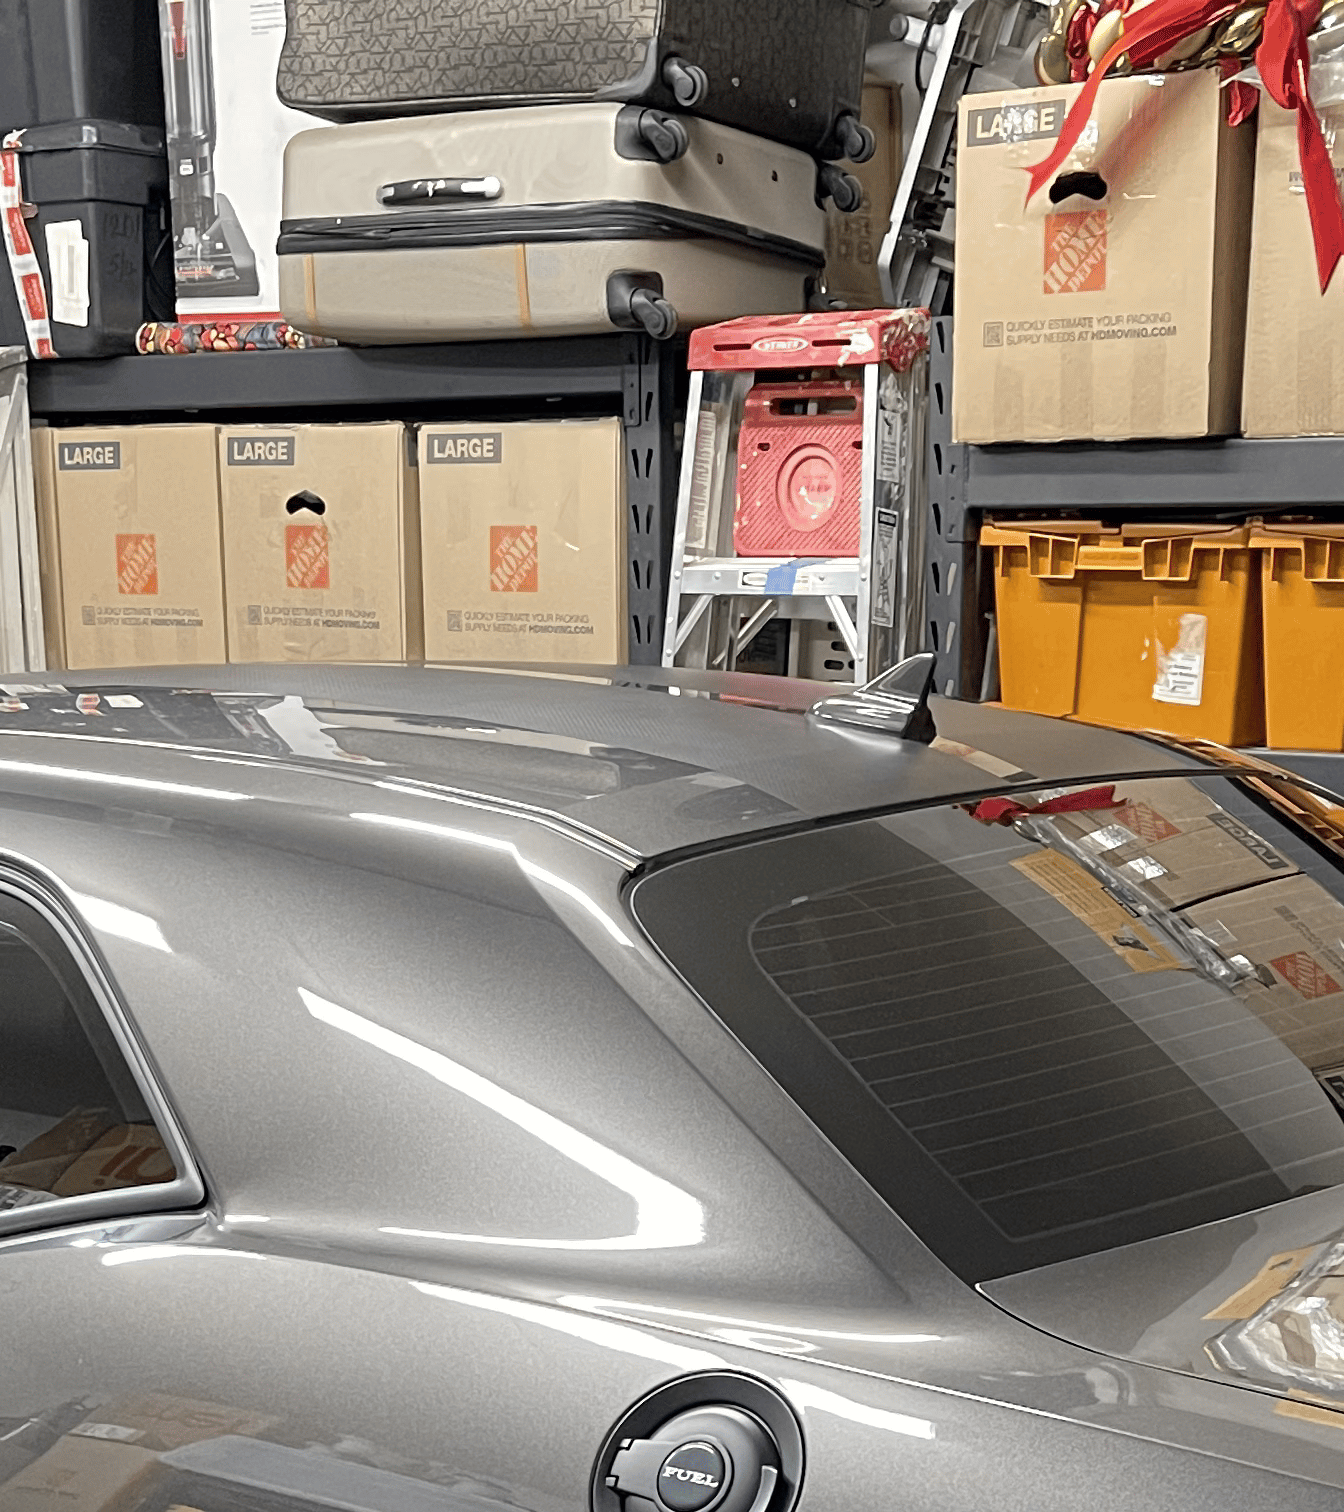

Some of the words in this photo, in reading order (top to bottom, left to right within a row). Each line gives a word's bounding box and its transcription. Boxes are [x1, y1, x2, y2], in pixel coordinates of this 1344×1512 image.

[975, 107, 1056, 139] LAGE
[1005, 319, 1046, 333] QUICKLY
[1047, 316, 1093, 330] ESTIMATE
[1096, 314, 1124, 327] YOUR
[1126, 312, 1172, 325] PACKING
[1006, 332, 1042, 346] SUPPLY
[1043, 331, 1076, 343] NEEDS
[1076, 330, 1091, 341] AT
[1091, 325, 1177, 341] HDMOVING.COM
[64, 446, 114, 465] LARGE
[233, 441, 288, 461] LARGE
[433, 437, 494, 458] LARGE
[662, 1465, 719, 1488] FUEL
